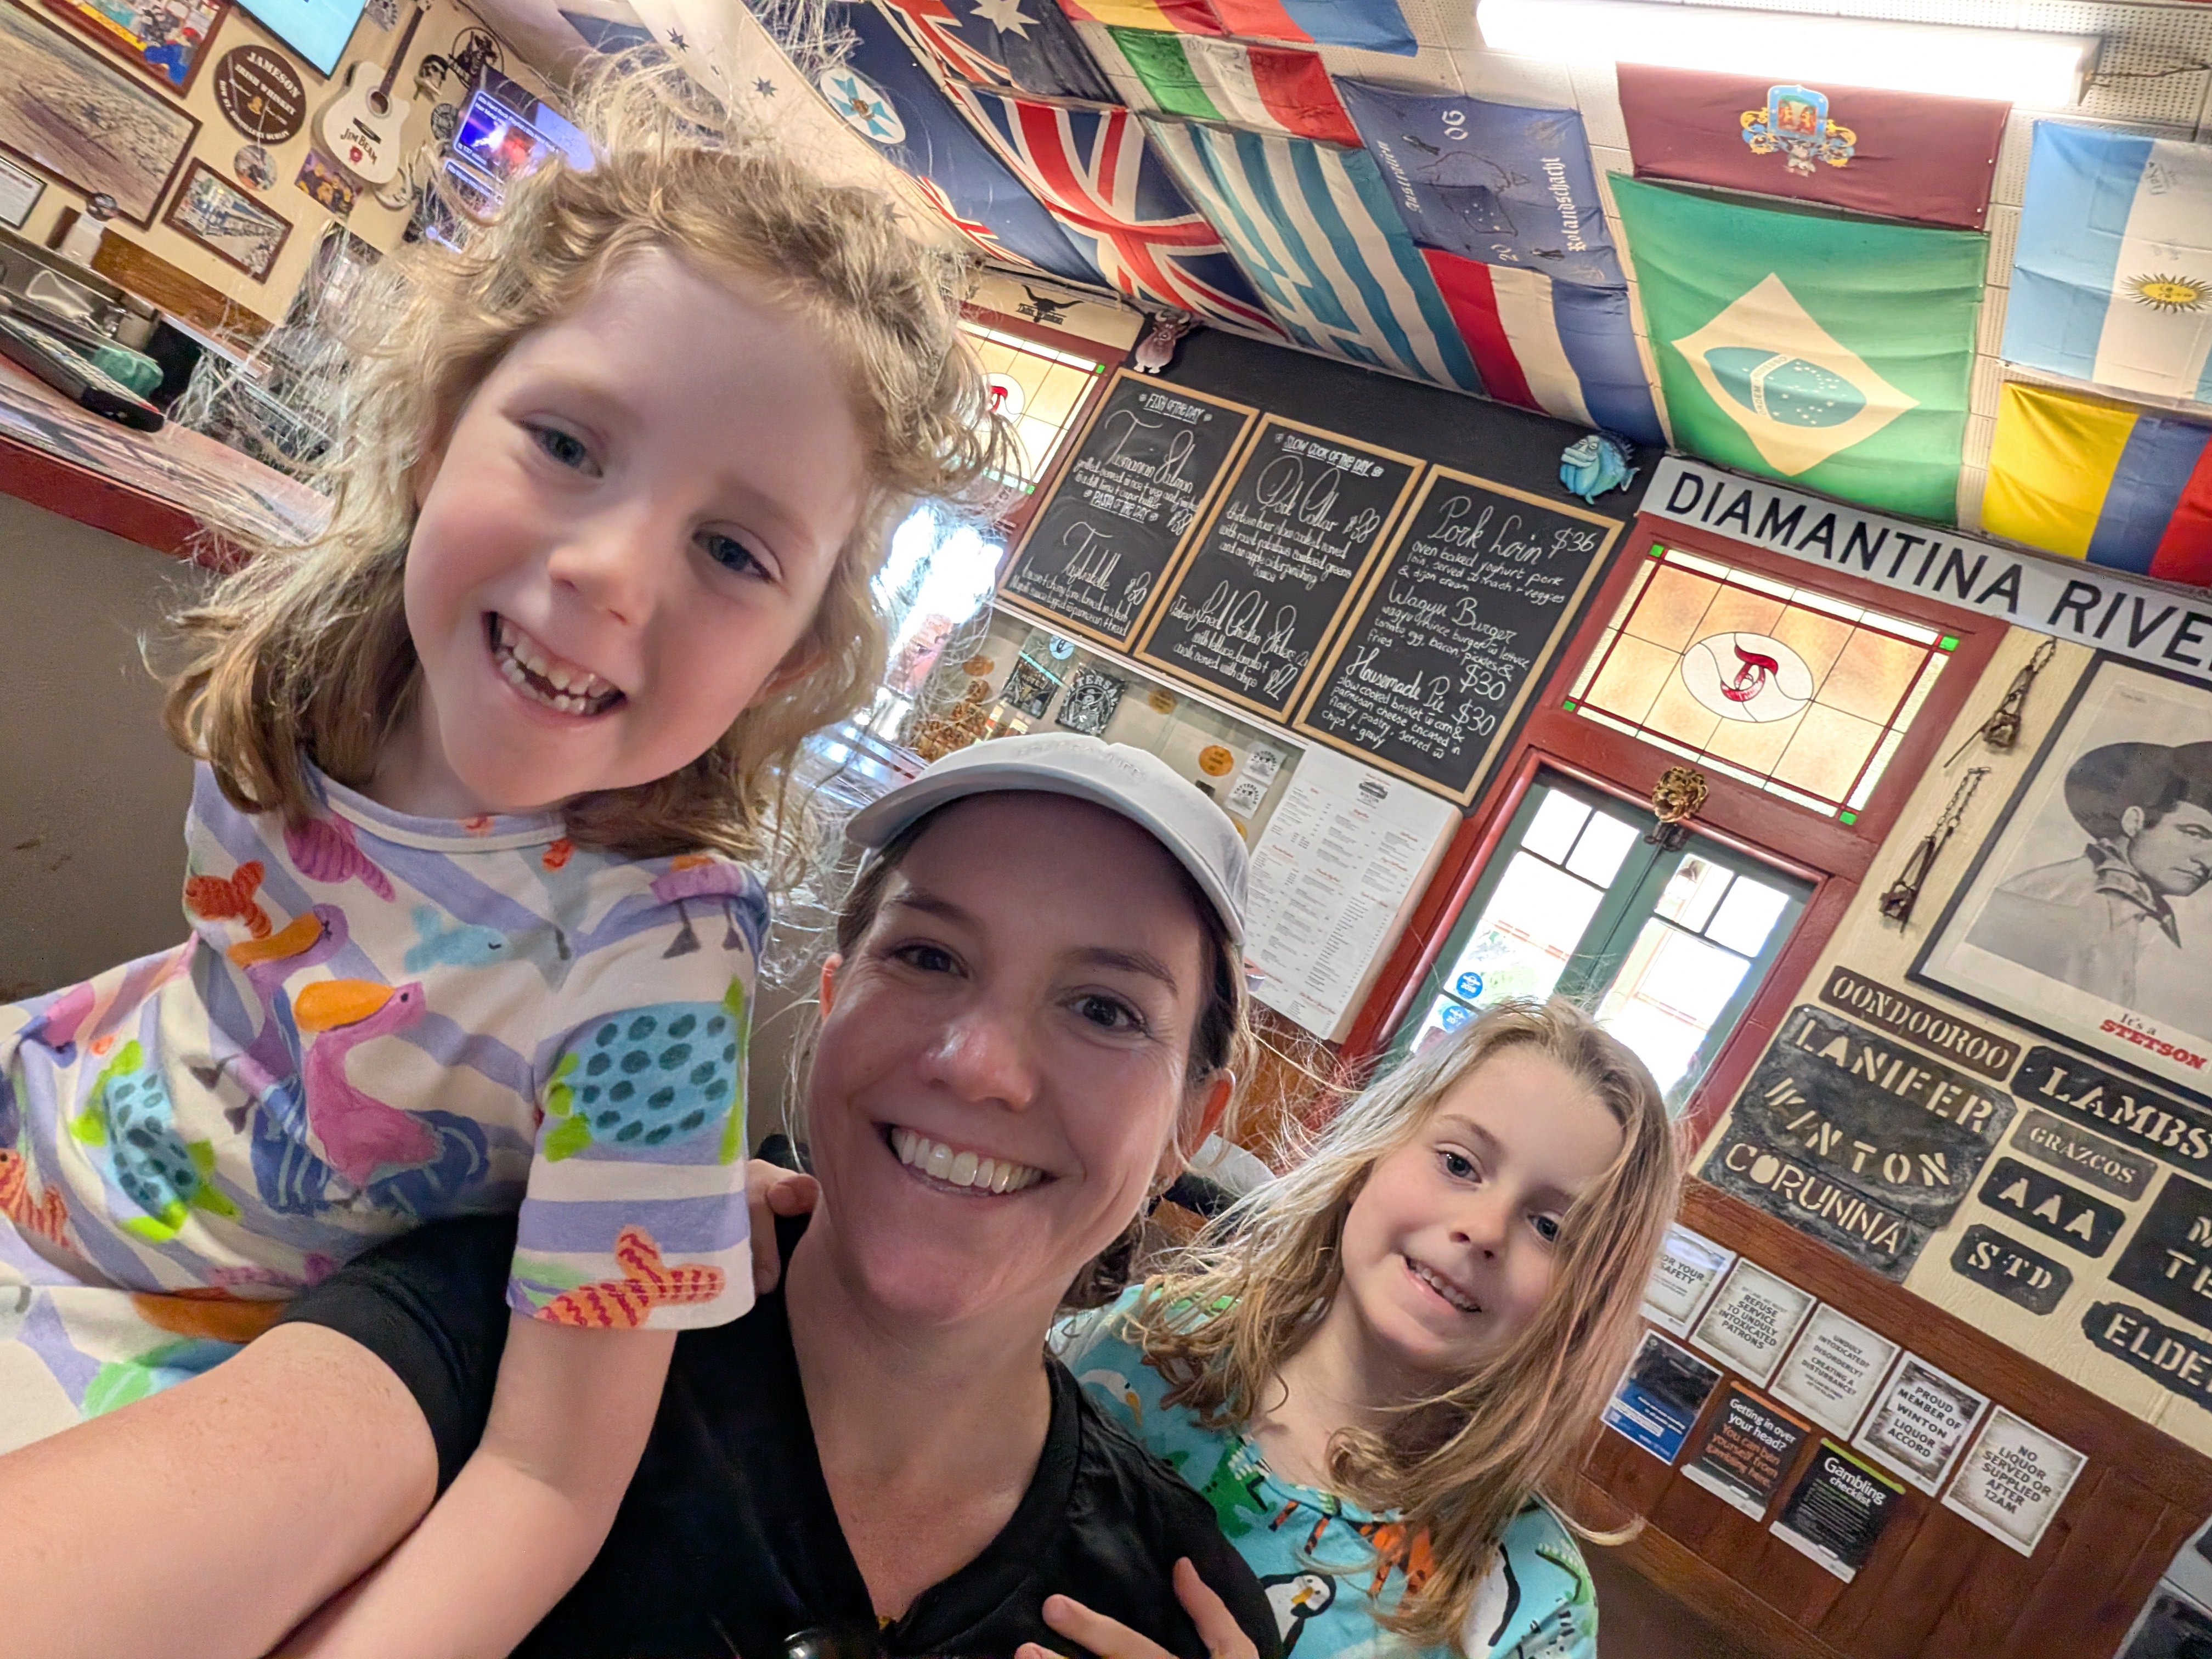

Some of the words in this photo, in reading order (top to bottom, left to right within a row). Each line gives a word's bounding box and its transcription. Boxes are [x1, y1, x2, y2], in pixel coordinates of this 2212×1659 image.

[247, 52, 301, 98] JAMESON
[341, 127, 359, 142] JIM
[358, 135, 377, 165] BEAM
[1144, 391, 1166, 412] FISH
[1184, 405, 1205, 419] DAY
[1153, 430, 1195, 493] Salmon
[1283, 433, 1308, 455] SLOW
[1306, 441, 1331, 460] COOK
[1336, 453, 1355, 469] THE
[1351, 455, 1375, 477] DAY
[1090, 489, 1114, 510] PASTA
[1132, 505, 1151, 520] DAY
[1146, 484, 1164, 504] veg
[1299, 467, 1340, 532] Collar
[1427, 496, 1493, 549] Pork
[1489, 515, 1542, 565] Loin
[1548, 528, 1596, 558] $36
[1321, 563, 1352, 581] greens
[1412, 541, 1437, 556] oven
[1440, 551, 1479, 567] baked
[1474, 562, 1525, 580] yoghurt
[1523, 567, 1565, 597] pork
[1433, 562, 1465, 578] served
[1525, 589, 1565, 606] veggies
[1666, 472, 2023, 614] DIAMANTINA
[2047, 580, 2212, 671] RIVE
[1225, 590, 1268, 645] Chicken
[1383, 581, 1447, 629] Wagyu
[1452, 597, 1516, 648] Burger
[1368, 633, 1392, 647] fries
[1414, 614, 1450, 637] mince
[1452, 632, 1487, 654] burger
[1236, 665, 1257, 691] chips
[1346, 646, 1423, 700] Housemade
[1423, 676, 1450, 713] Pie
[1451, 699, 1496, 736] $30
[1460, 664, 1511, 701] $30
[1497, 664, 1514, 682] &
[1331, 686, 1374, 711] parmesan
[1376, 708, 1407, 726] cheese
[1412, 724, 1449, 747] encased
[1337, 676, 1360, 691] slow
[1359, 686, 1391, 704] cooked
[1390, 697, 1423, 721] brisket
[1452, 726, 1465, 742] &
[1322, 710, 1346, 730] chips
[1356, 728, 1385, 749] gravy
[1398, 730, 1431, 752] served
[1832, 975, 2011, 1071] OONDOOROO
[2120, 1013, 2143, 1030] It's
[2146, 1027, 2157, 1036] a
[2099, 1019, 2208, 1070] STETSON
[1795, 1018, 1995, 1133] LANIFER
[1764, 1078, 1950, 1187] WINTON
[2029, 1125, 2136, 1185] GRAZCOS
[1723, 1143, 1902, 1255] CORUNNA
[1659, 1261, 1695, 1286] SAFETY
[1676, 1262, 1705, 1283] YOUR
[1967, 1241, 2053, 1291] STD
[1725, 1302, 1741, 1317] TO
[1739, 1311, 1779, 1338] UNDULY
[1736, 1300, 1776, 1327] SERVICE
[1742, 1293, 1779, 1319] REFUSE
[1717, 1308, 1778, 1347] INTOXICATED
[1719, 1319, 1765, 1351] PATRONS
[1832, 1334, 1864, 1355] UNDULY
[1811, 1344, 1865, 1379] DISORDERLY?
[1816, 1334, 1872, 1369] INTOXICATED?
[1799, 1359, 1859, 1397] DISTURBANCE?
[1809, 1356, 1849, 1383] CREATING
[1846, 1377, 1855, 1387] A
[1895, 1387, 1946, 1420] MEMBER
[1943, 1415, 1963, 1432] OF
[1913, 1385, 1955, 1414] PROUD
[1727, 1397, 1765, 1424] Getting
[1762, 1417, 1776, 1431] in
[1772, 1424, 1797, 1444] over
[1728, 1413, 1753, 1431] your
[1752, 1426, 1788, 1453] head?
[1891, 1417, 1939, 1450] LIQUOR
[1894, 1402, 1949, 1439] WINTON
[1713, 1433, 1754, 1464] yourself
[1751, 1458, 1781, 1479] from
[1719, 1425, 1742, 1442] You
[1742, 1436, 1762, 1453] can
[1762, 1447, 1782, 1464] ban
[1886, 1426, 1934, 1459] ACCORD
[2017, 1445, 2039, 1463] NO
[1824, 1457, 1886, 1505] Gambling
[1982, 1449, 2032, 1485] SERVED
[2031, 1480, 2052, 1497] OR
[1997, 1446, 2047, 1481] LIQUOR
[1828, 1475, 1872, 1507] checklist
[1980, 1462, 2043, 1504] SUPPLIED
[1983, 1488, 2018, 1514] 12AM
[1984, 1477, 2026, 1507] AFTER
